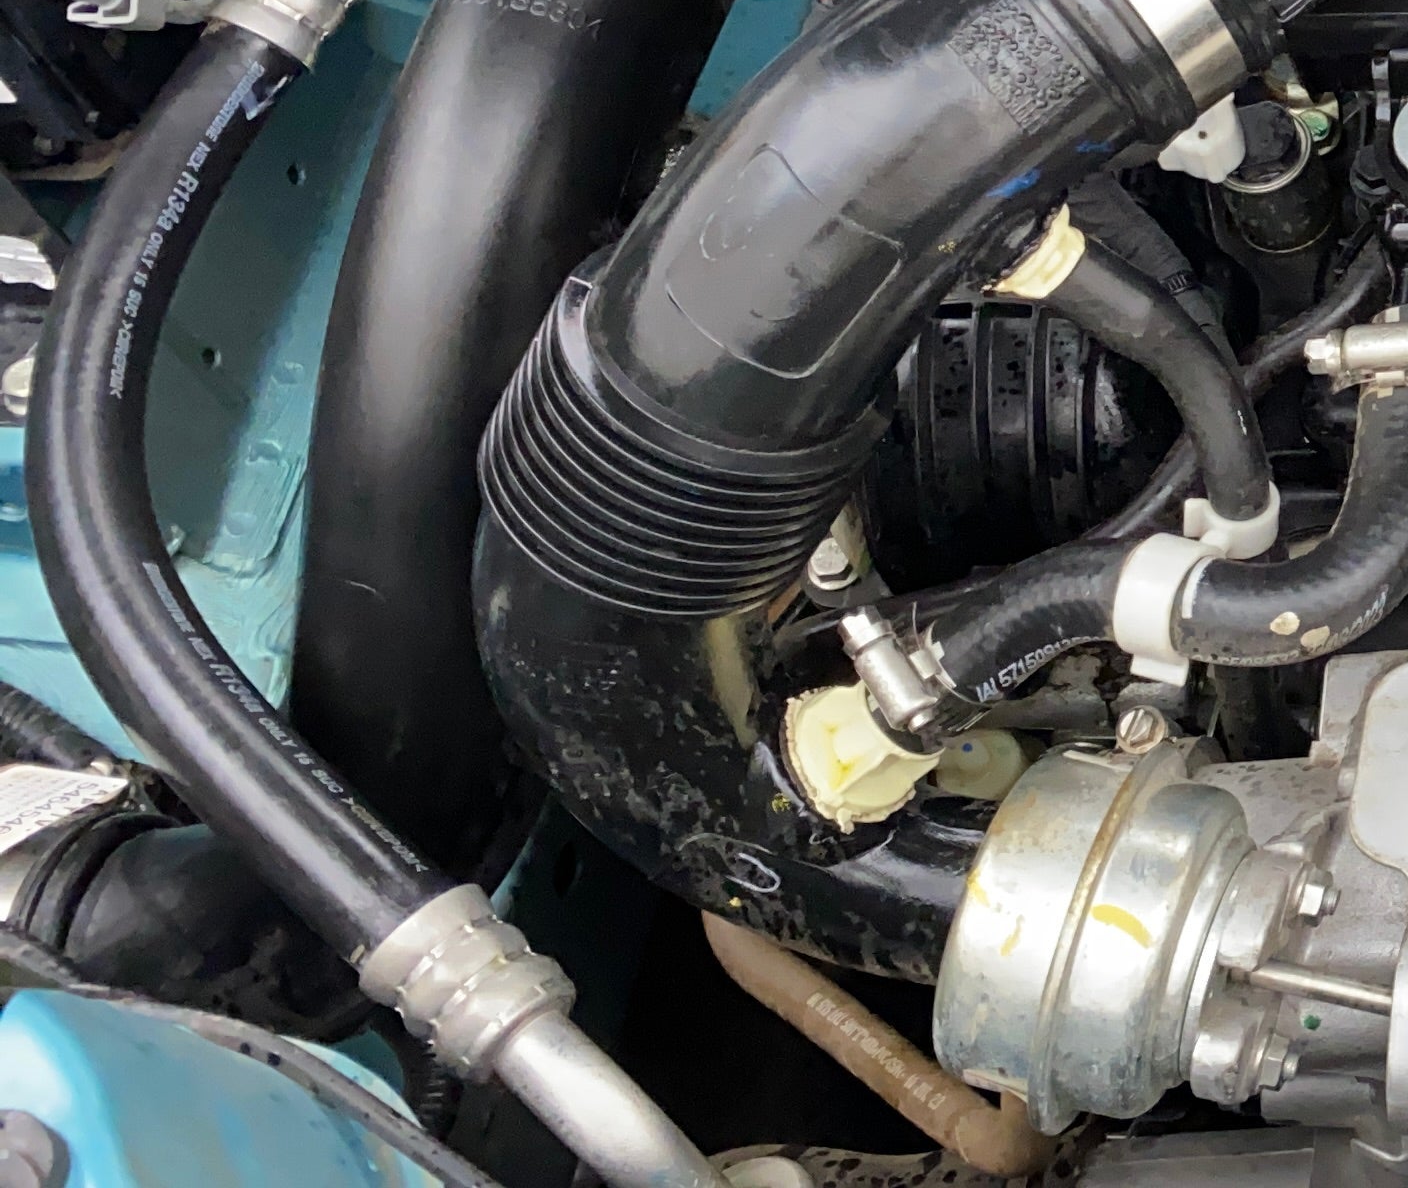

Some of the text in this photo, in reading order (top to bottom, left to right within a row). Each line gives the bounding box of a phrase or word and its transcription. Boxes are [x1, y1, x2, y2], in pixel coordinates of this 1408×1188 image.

[158, 170, 200, 232] R134a
[139, 231, 164, 271] ONLY
[257, 716, 298, 749] ONLY
